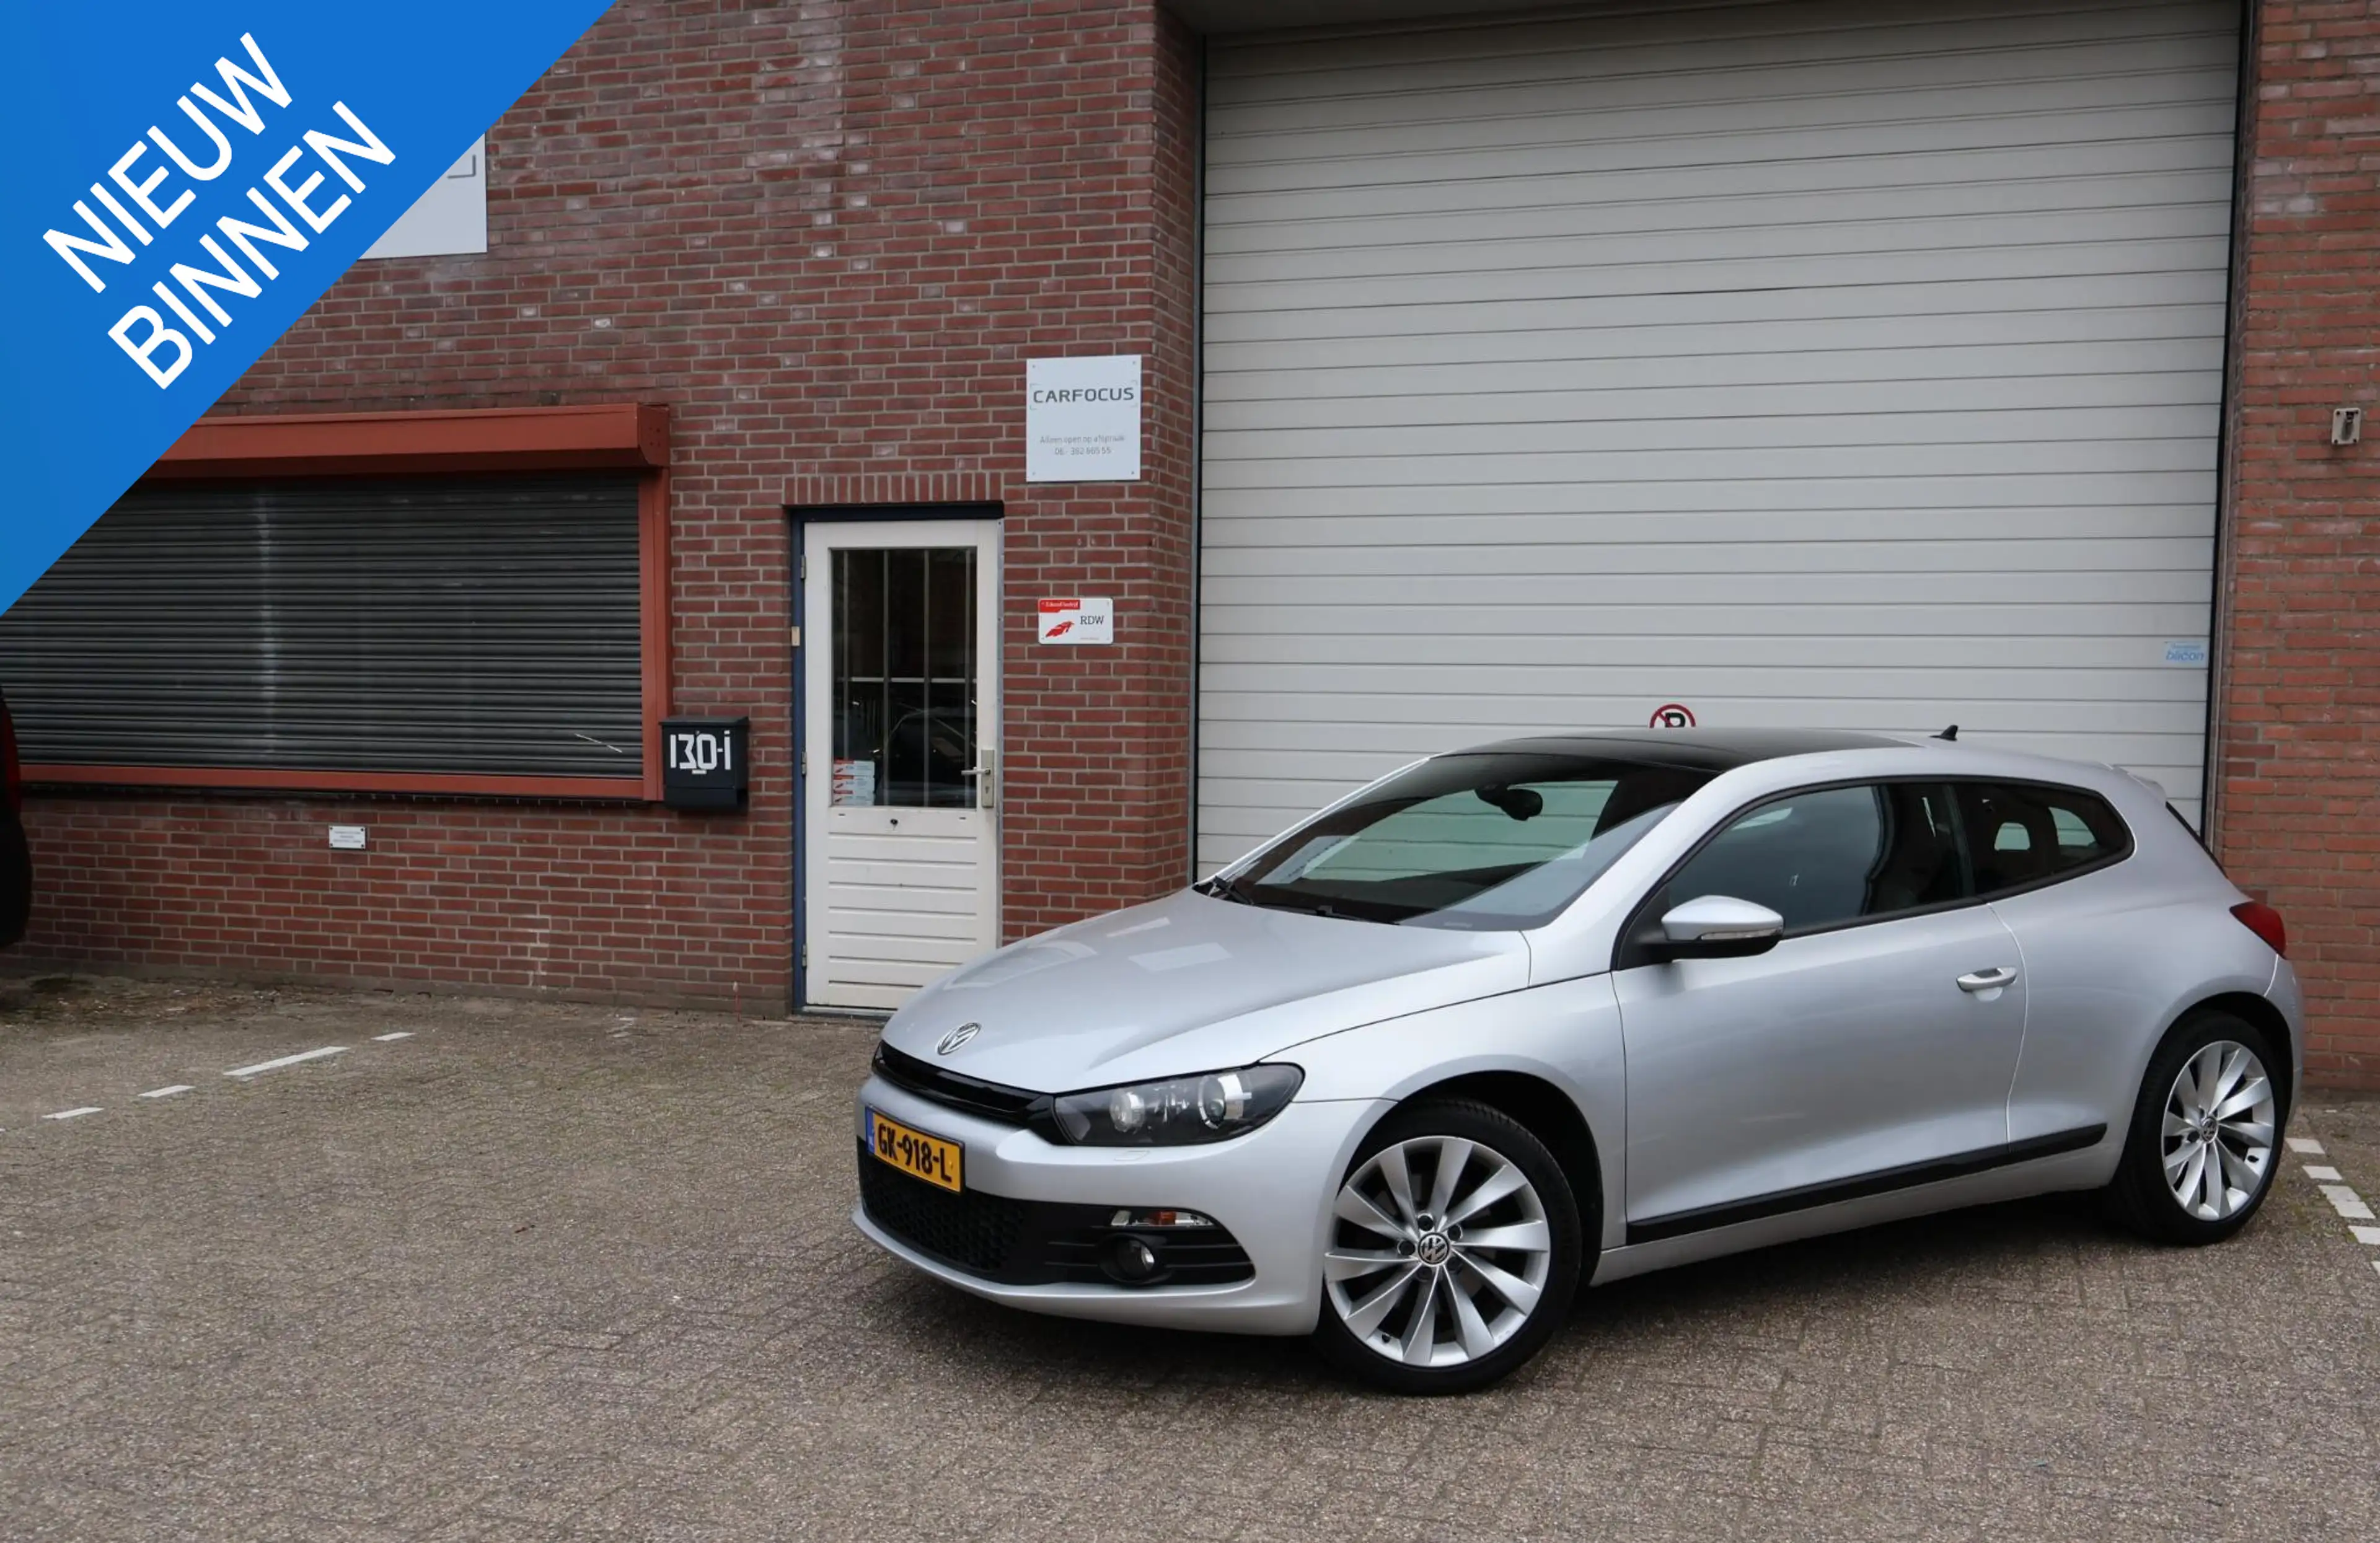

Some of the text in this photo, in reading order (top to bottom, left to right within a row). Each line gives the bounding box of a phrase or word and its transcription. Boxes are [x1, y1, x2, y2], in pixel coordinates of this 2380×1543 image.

[1033, 387, 1134, 403] CARFOCUS
[1080, 615, 1104, 625] RDW
[878, 1123, 952, 1183] GK-918-L
